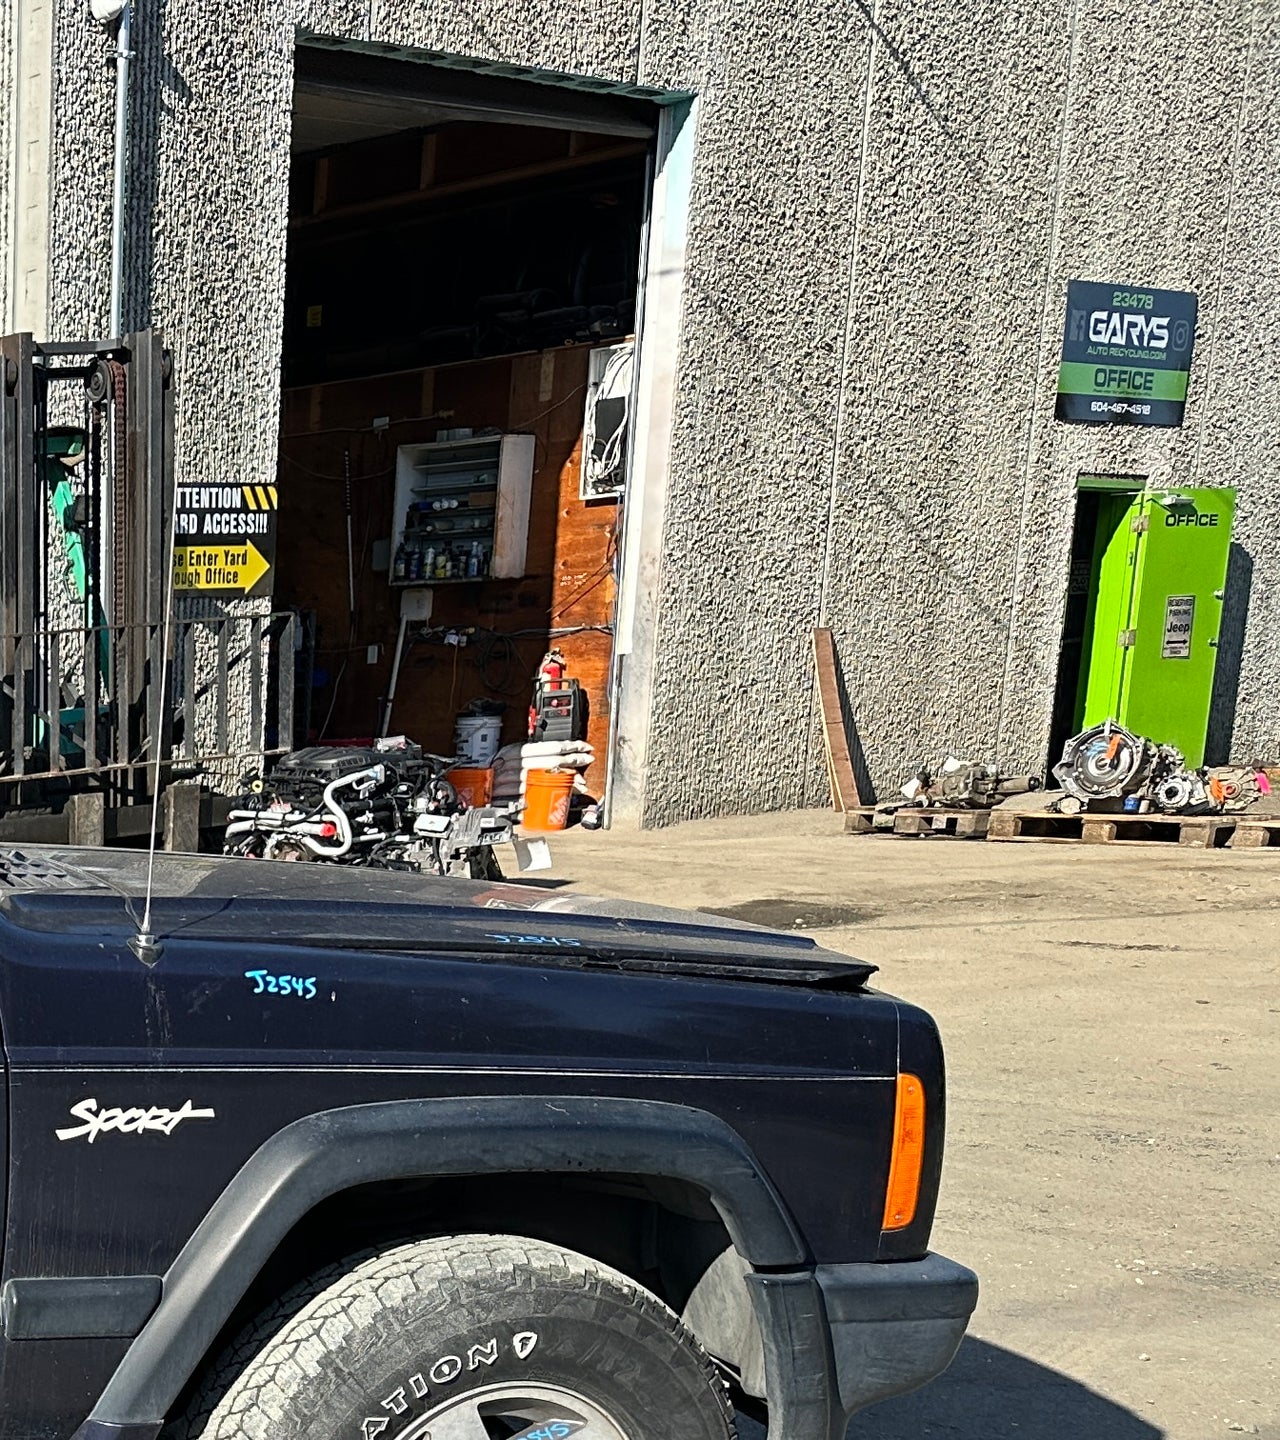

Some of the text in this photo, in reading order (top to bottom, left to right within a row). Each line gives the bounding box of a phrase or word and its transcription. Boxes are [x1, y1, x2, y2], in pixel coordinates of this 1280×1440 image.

[1112, 292, 1154, 309] 23478
[1090, 311, 1171, 349] GARYS
[1094, 367, 1155, 391] OFFICE
[176, 487, 242, 509] TTENTION
[203, 512, 268, 534] ACCESS!!!
[1165, 513, 1219, 527] OFFICE
[189, 549, 219, 567] Enter
[224, 549, 248, 567] Yard
[205, 568, 239, 585] Office
[1166, 621, 1190, 634] Jeep
[245, 969, 317, 1000] J2545
[55, 1098, 216, 1144] Sport
